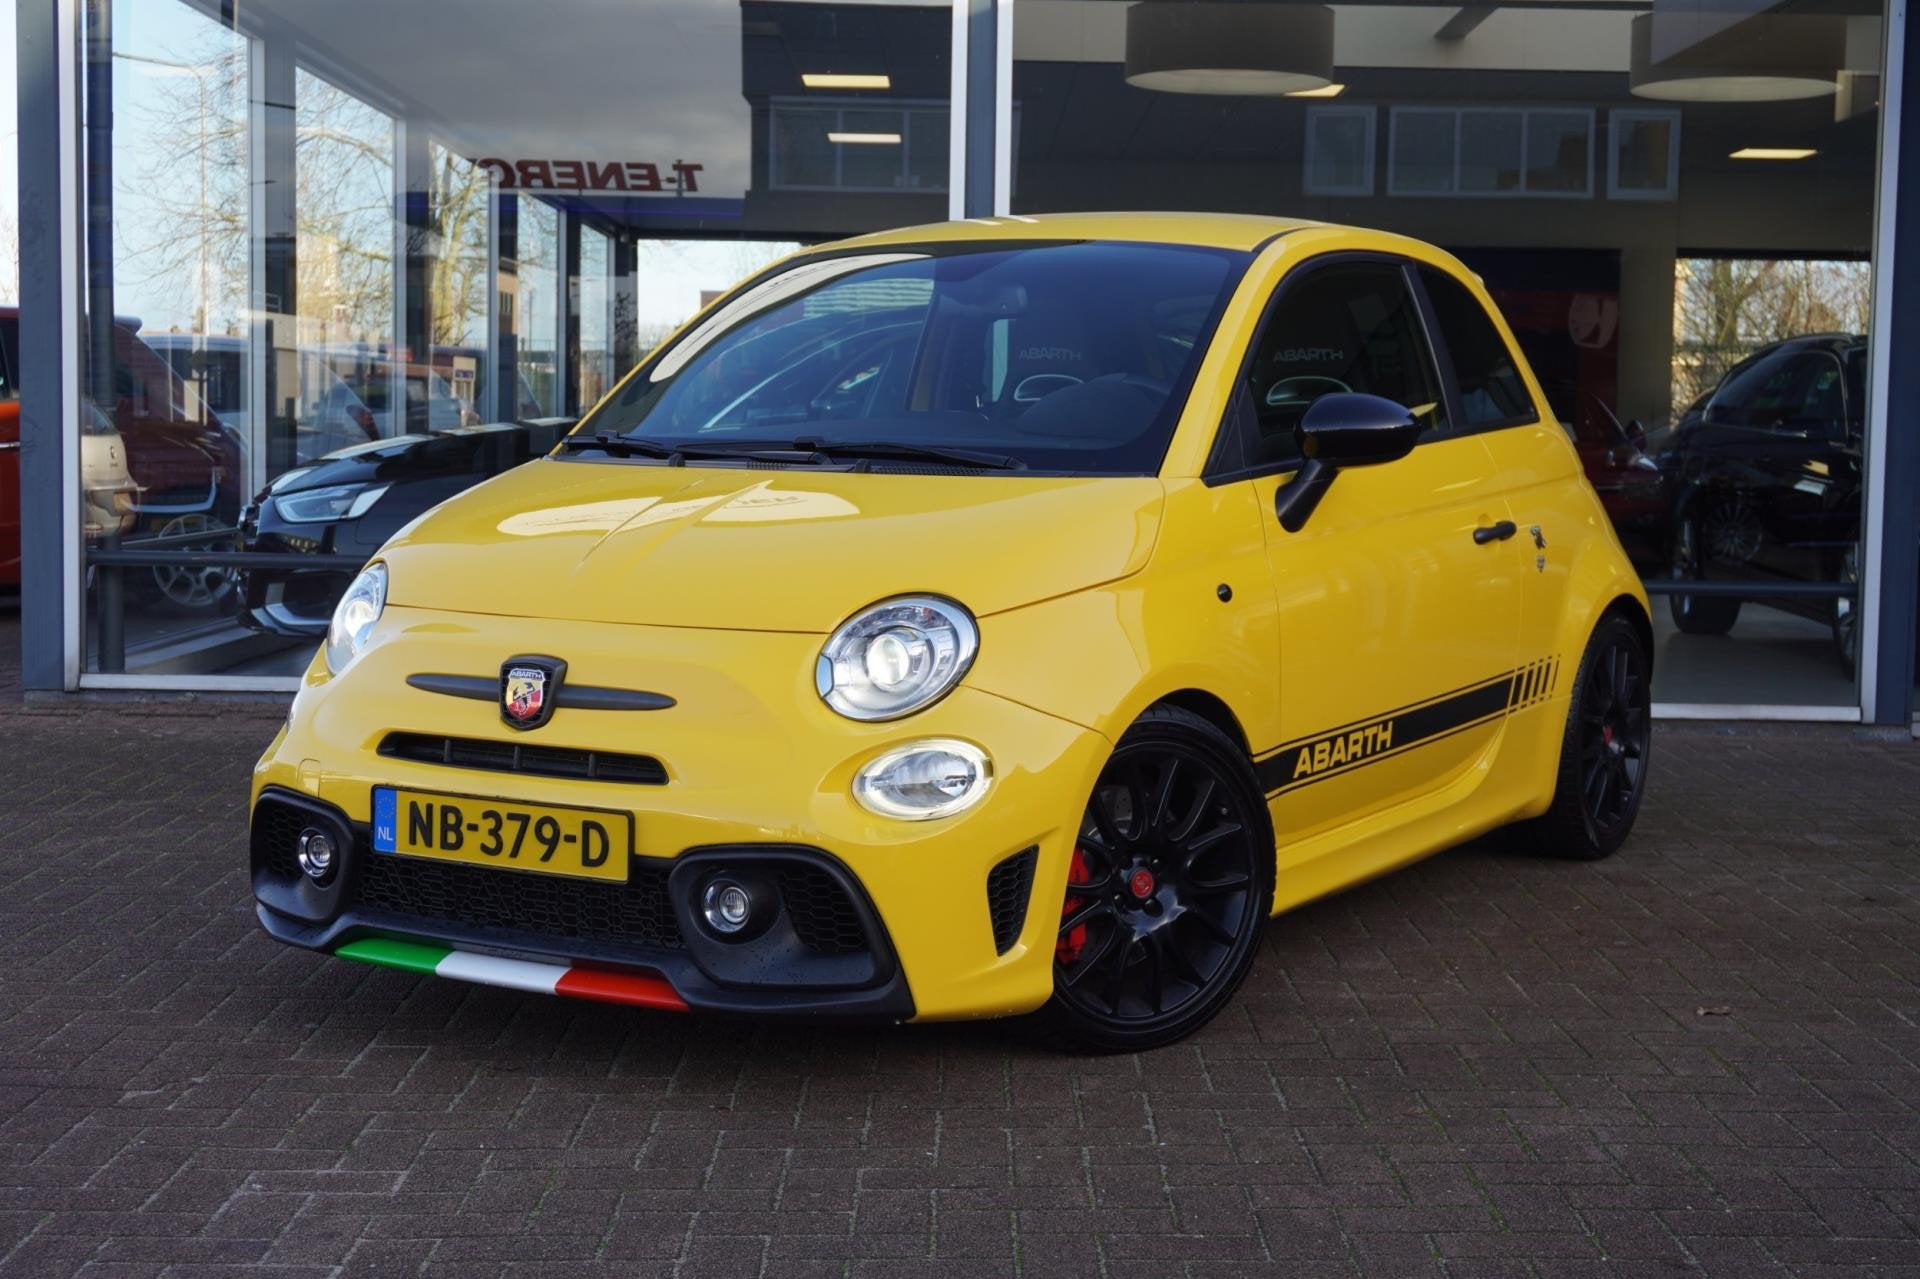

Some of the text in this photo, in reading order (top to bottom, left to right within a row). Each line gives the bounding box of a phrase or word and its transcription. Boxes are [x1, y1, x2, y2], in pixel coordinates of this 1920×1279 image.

[1018, 346, 1082, 361] ABARTH
[1272, 347, 1344, 363] ABARTH
[510, 671, 542, 679] ABARTH
[1293, 721, 1393, 779] ABARTH
[377, 826, 393, 841] NL
[409, 801, 609, 867] NB-379-D
